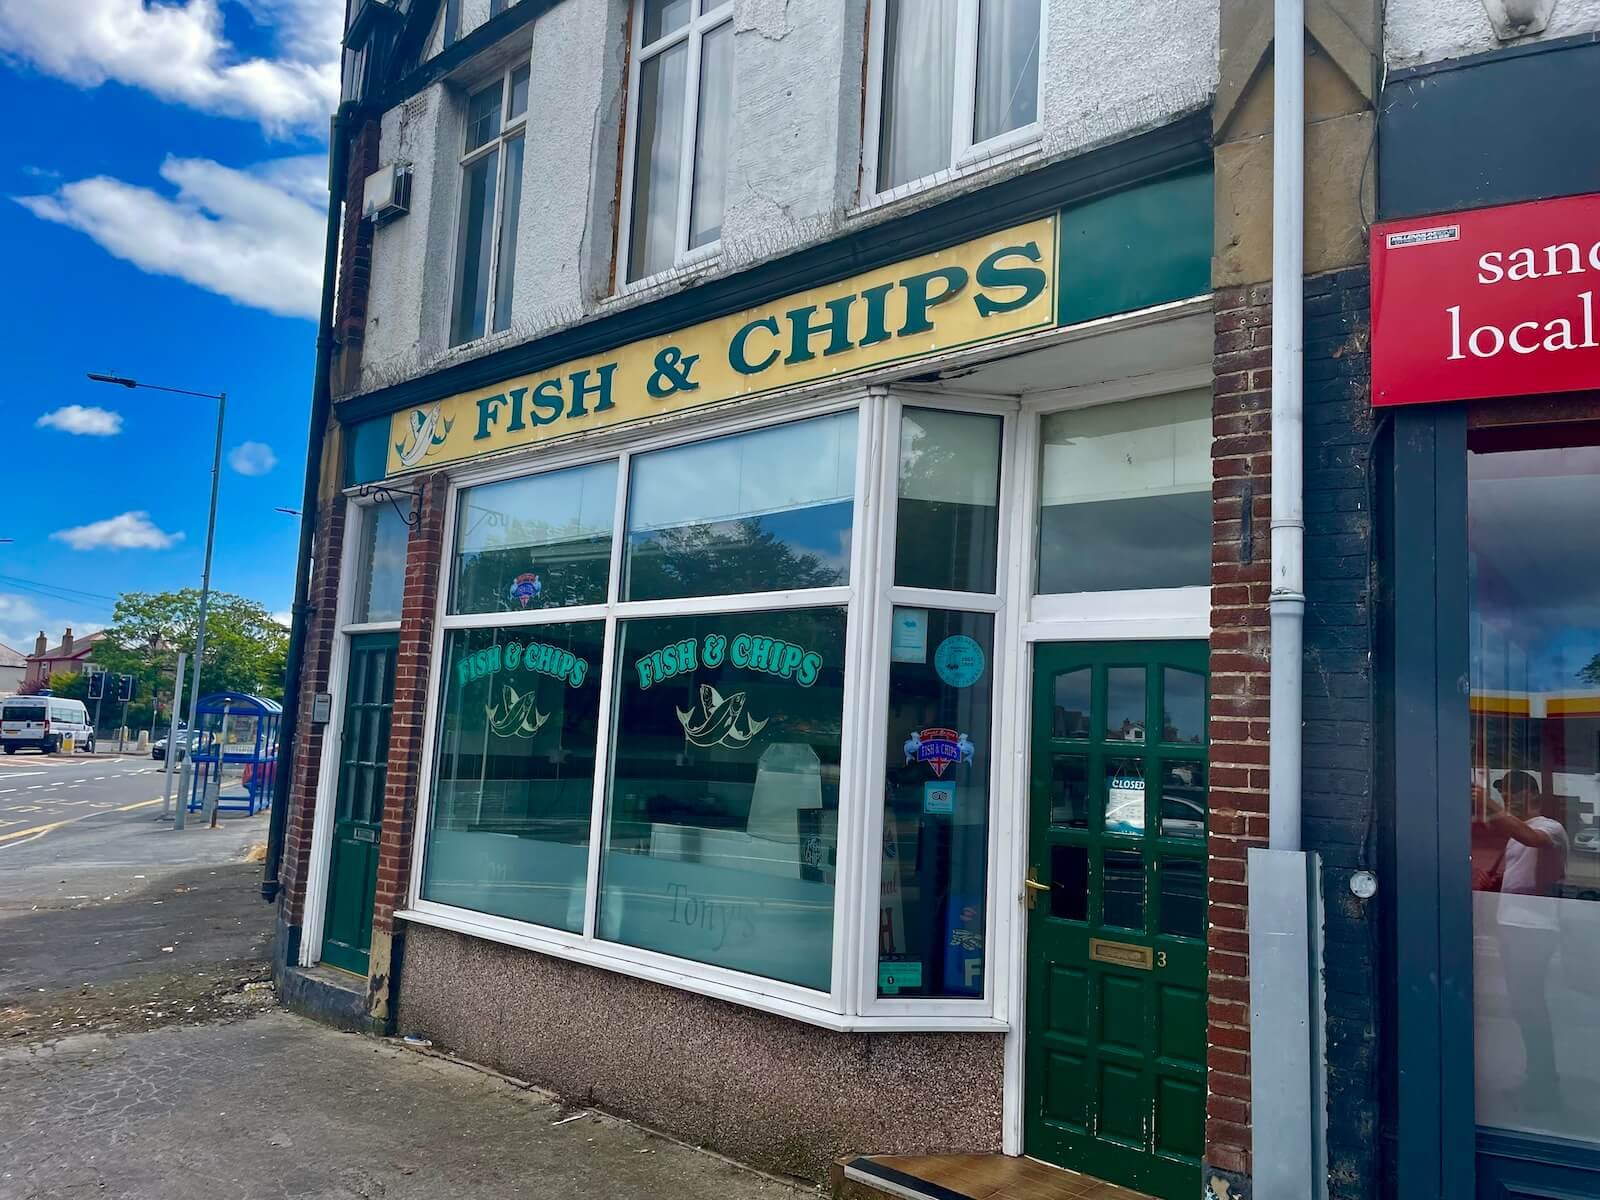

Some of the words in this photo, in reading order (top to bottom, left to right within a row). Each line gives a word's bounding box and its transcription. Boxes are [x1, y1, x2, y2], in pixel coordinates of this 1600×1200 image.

[473, 362, 618, 440] FISH
[646, 346, 700, 398] &
[728, 241, 1047, 375] CHIPS
[1446, 291, 1600, 360] local
[456, 644, 502, 688] FISH
[504, 641, 523, 672] &
[524, 641, 588, 688] CHIPS
[635, 637, 698, 691] FISH
[702, 633, 727, 669] &
[730, 632, 823, 688] CHIPS
[1112, 779, 1145, 790] CLOSED
[1157, 951, 1167, 968] 3
